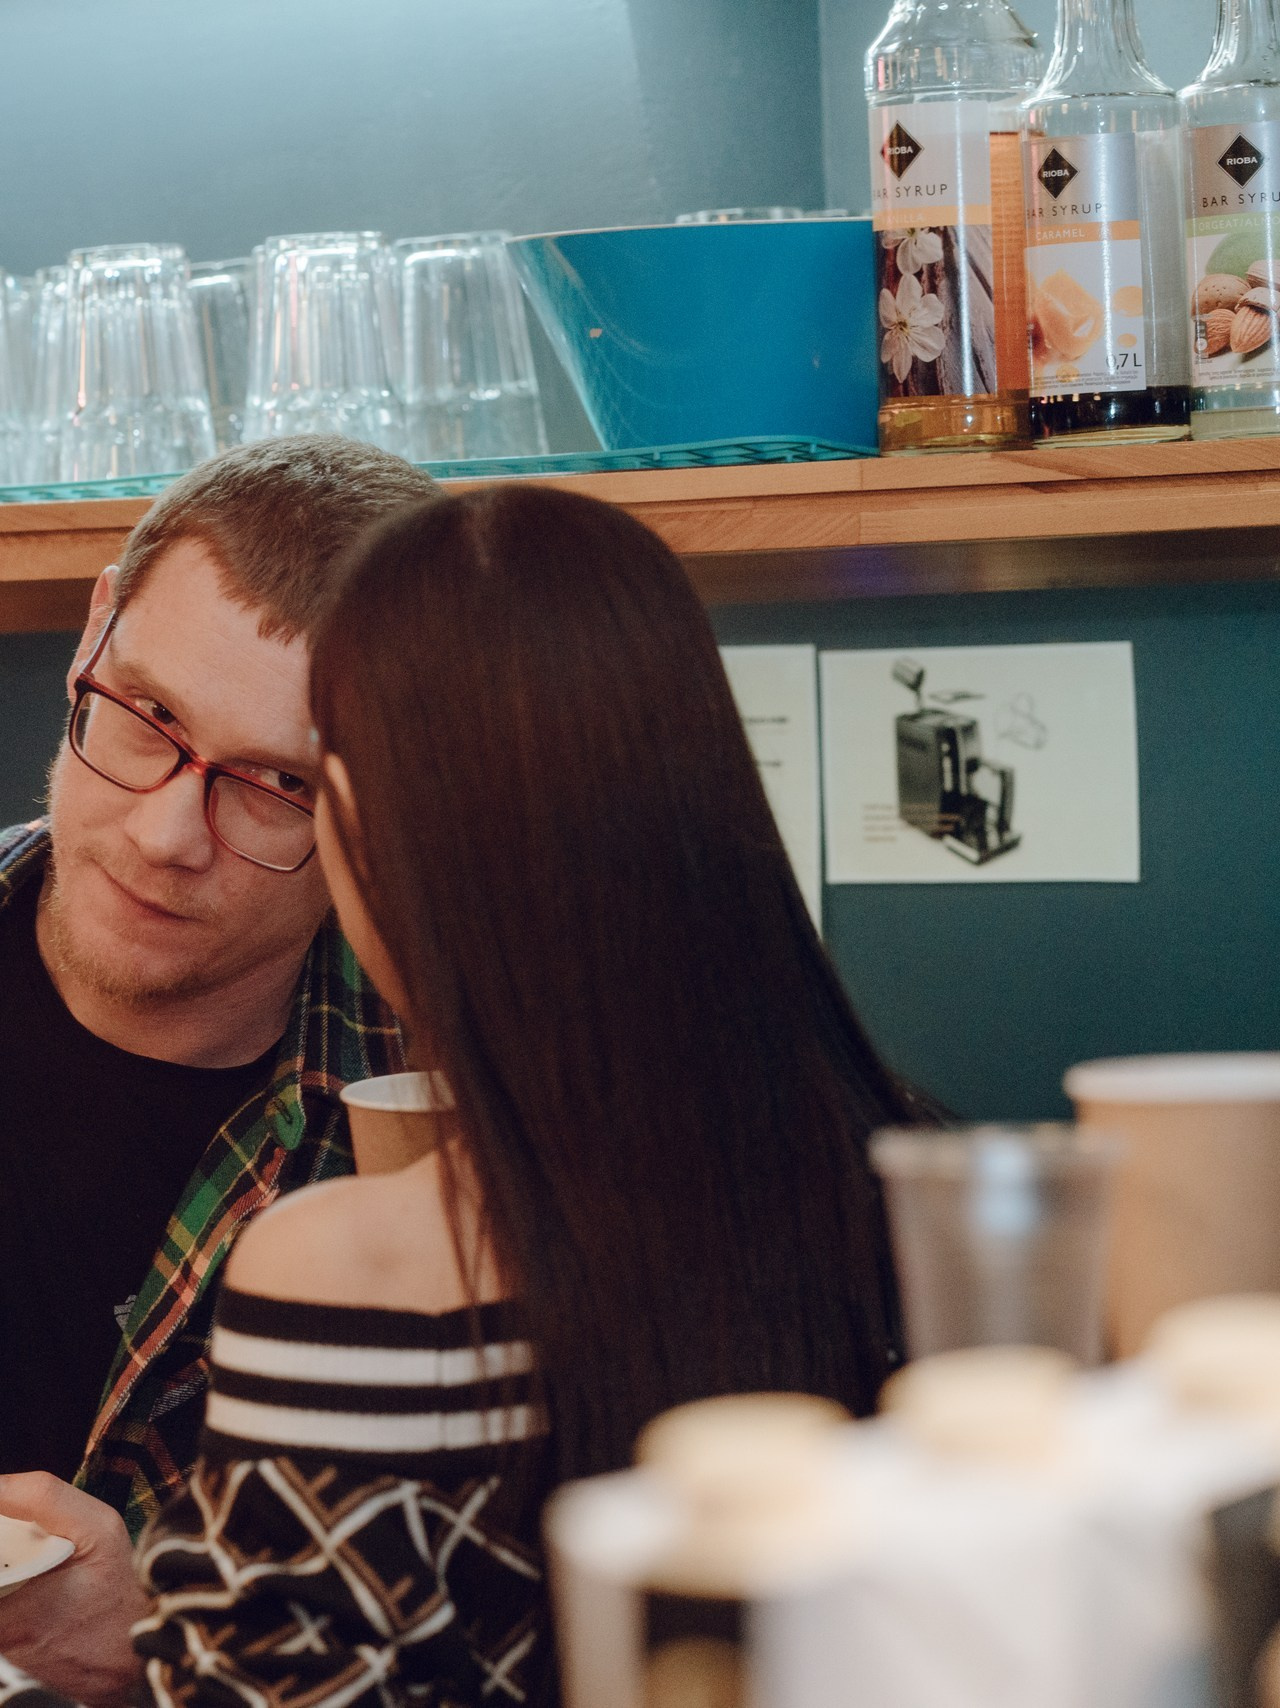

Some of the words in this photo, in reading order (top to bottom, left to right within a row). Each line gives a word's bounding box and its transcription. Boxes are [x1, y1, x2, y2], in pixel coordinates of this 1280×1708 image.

[886, 146, 914, 155] RIOBA
[1226, 156, 1258, 165] RIOBA
[1042, 169, 1070, 178] RIOBA
[896, 183, 948, 199] SYRUP
[1202, 195, 1229, 208] BAR
[1051, 202, 1103, 217] SYRUP
[1036, 227, 1086, 241] CARAMEL
[1133, 352, 1143, 367] L
